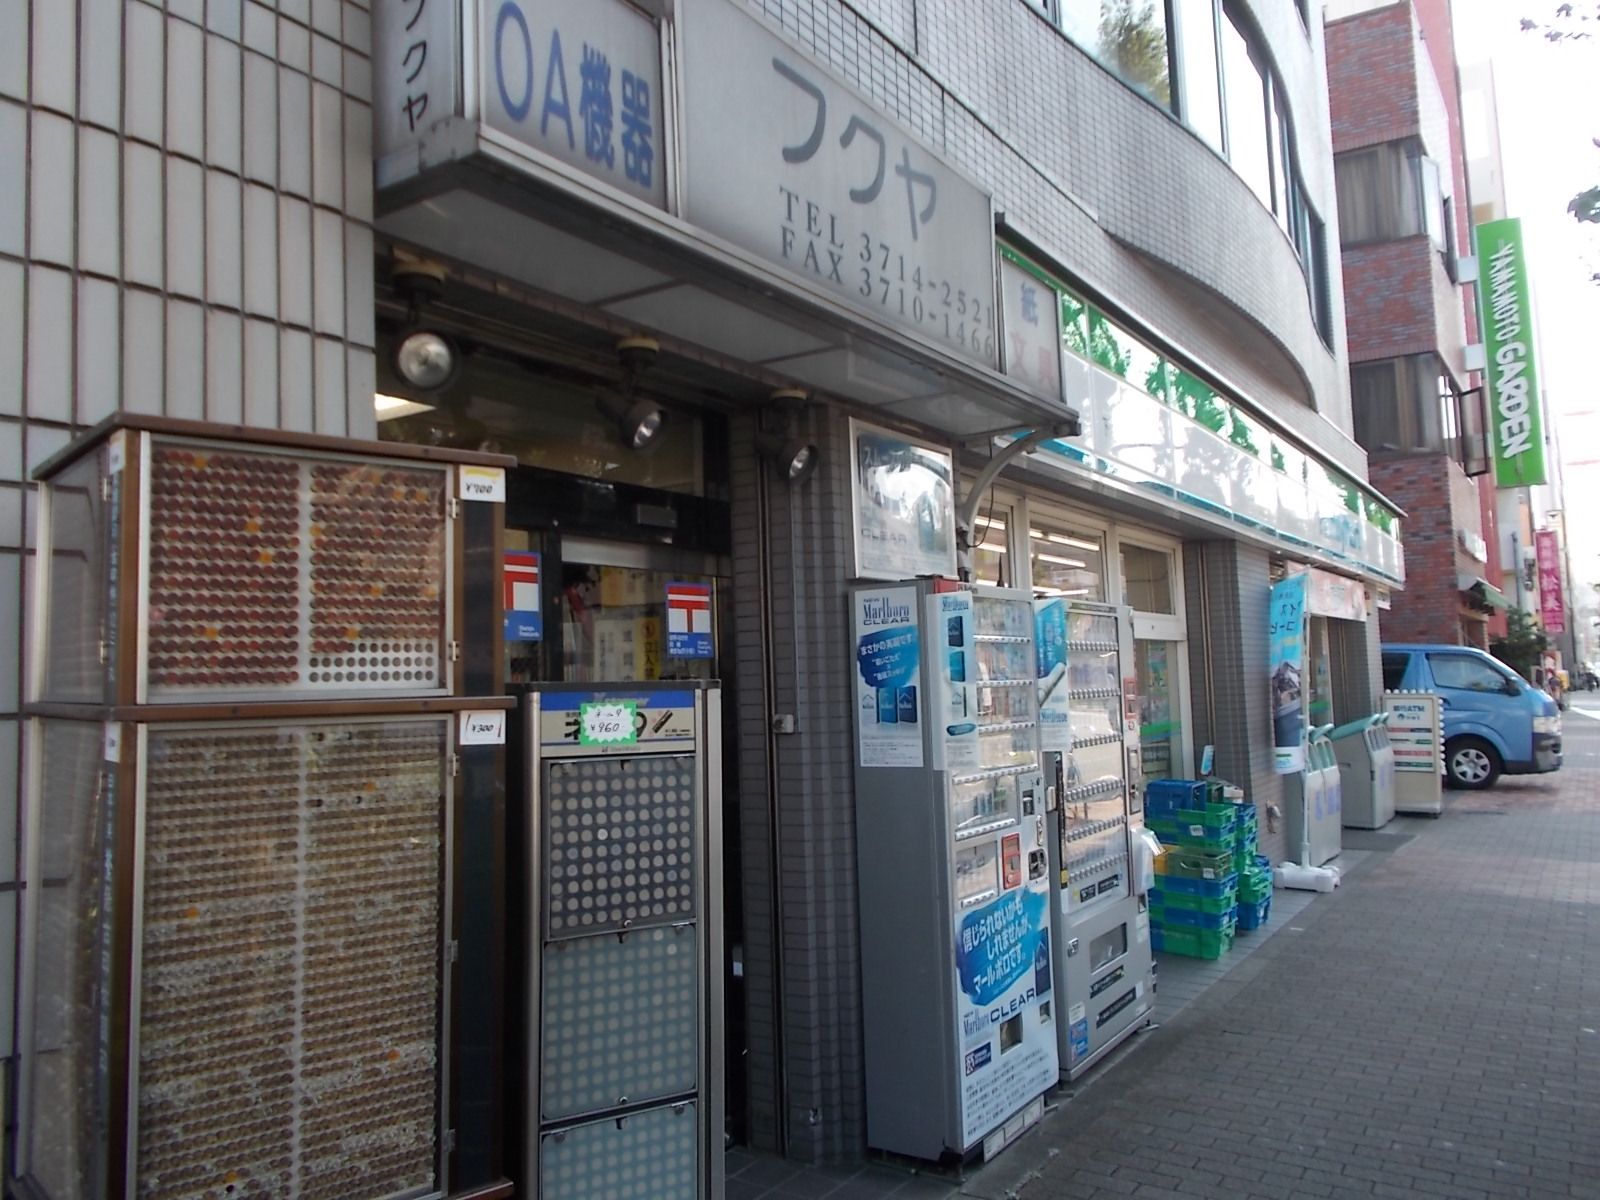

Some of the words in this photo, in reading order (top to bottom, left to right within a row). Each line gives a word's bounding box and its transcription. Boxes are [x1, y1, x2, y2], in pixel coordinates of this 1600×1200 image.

[495, 1, 653, 188] OA機器
[772, 57, 938, 242] フクヤ
[779, 185, 844, 250] TEL
[859, 232, 993, 331] 3714-2521
[781, 225, 843, 285] FAX
[859, 267, 994, 359] 3710-1466
[1489, 242, 1521, 341] YAMAMOTO
[1496, 341, 1533, 459] GARDEN
[863, 597, 910, 619] Marlboro
[863, 618, 910, 626] CLEAR
[591, 721, 620, 733] ¥960
[991, 987, 1036, 1023] CLEAR
